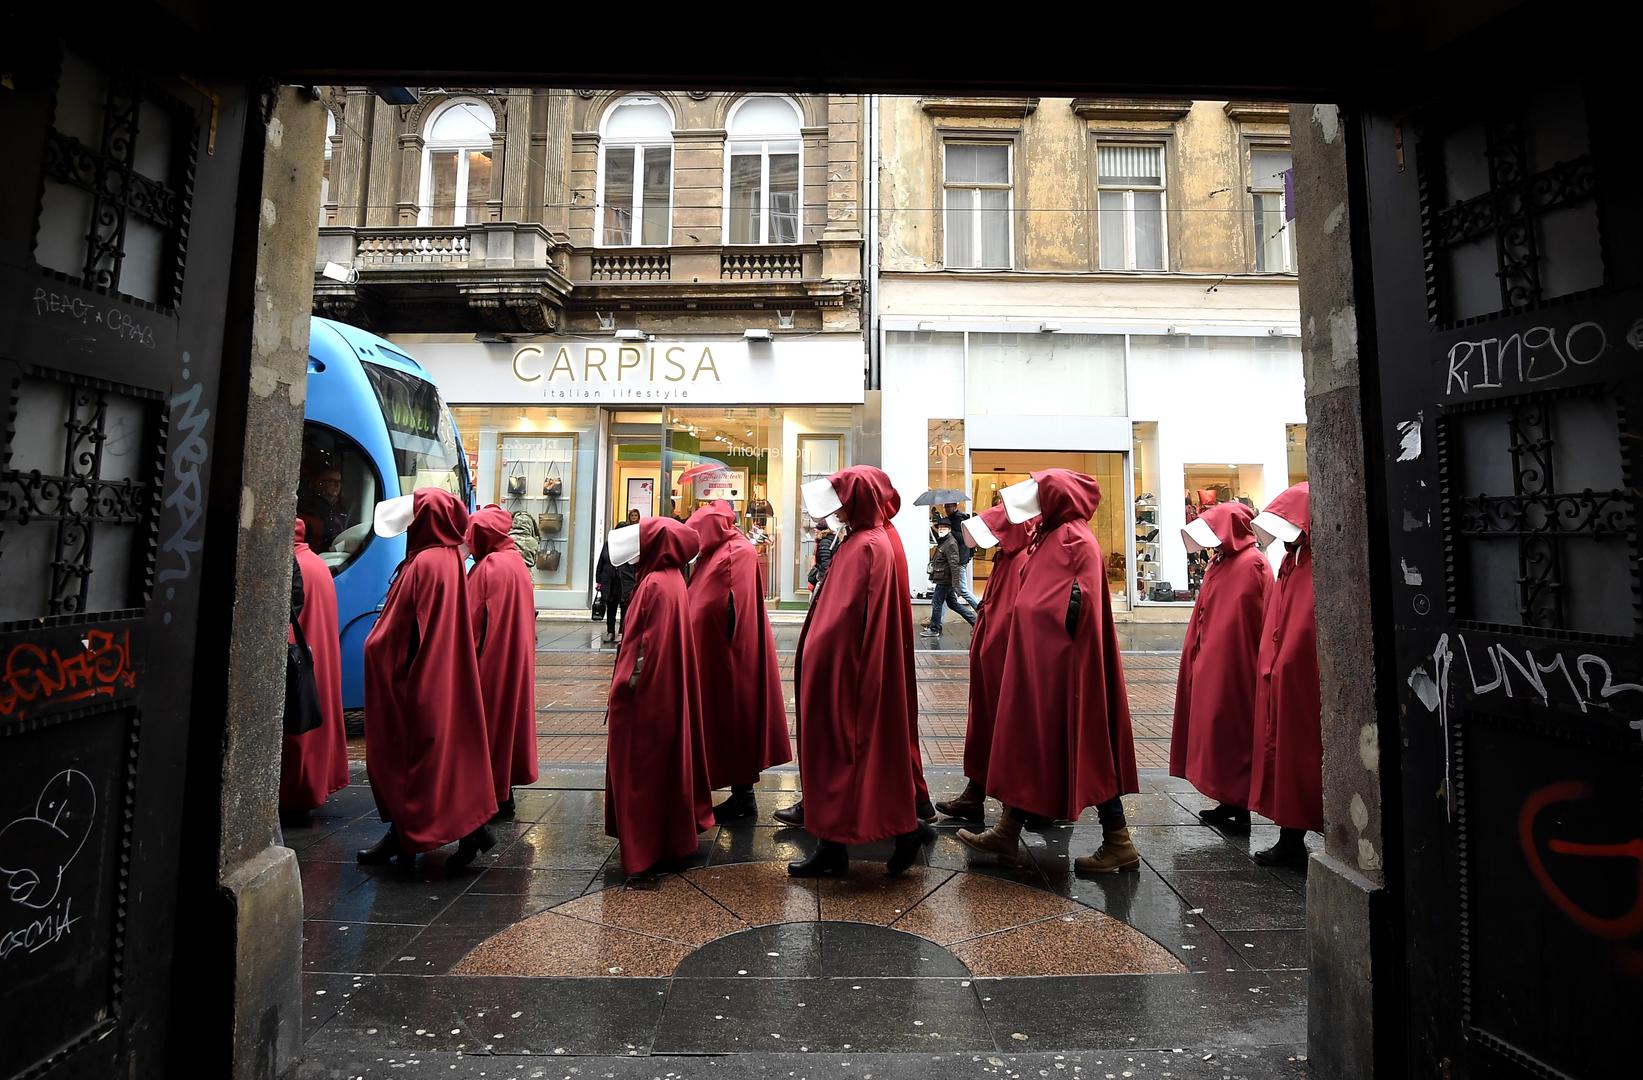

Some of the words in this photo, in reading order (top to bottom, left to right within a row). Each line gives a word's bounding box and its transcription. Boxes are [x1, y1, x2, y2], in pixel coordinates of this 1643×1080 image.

[512, 346, 720, 382] CARPISA
[543, 389, 600, 398] italian
[613, 389, 689, 400] lifestyle
